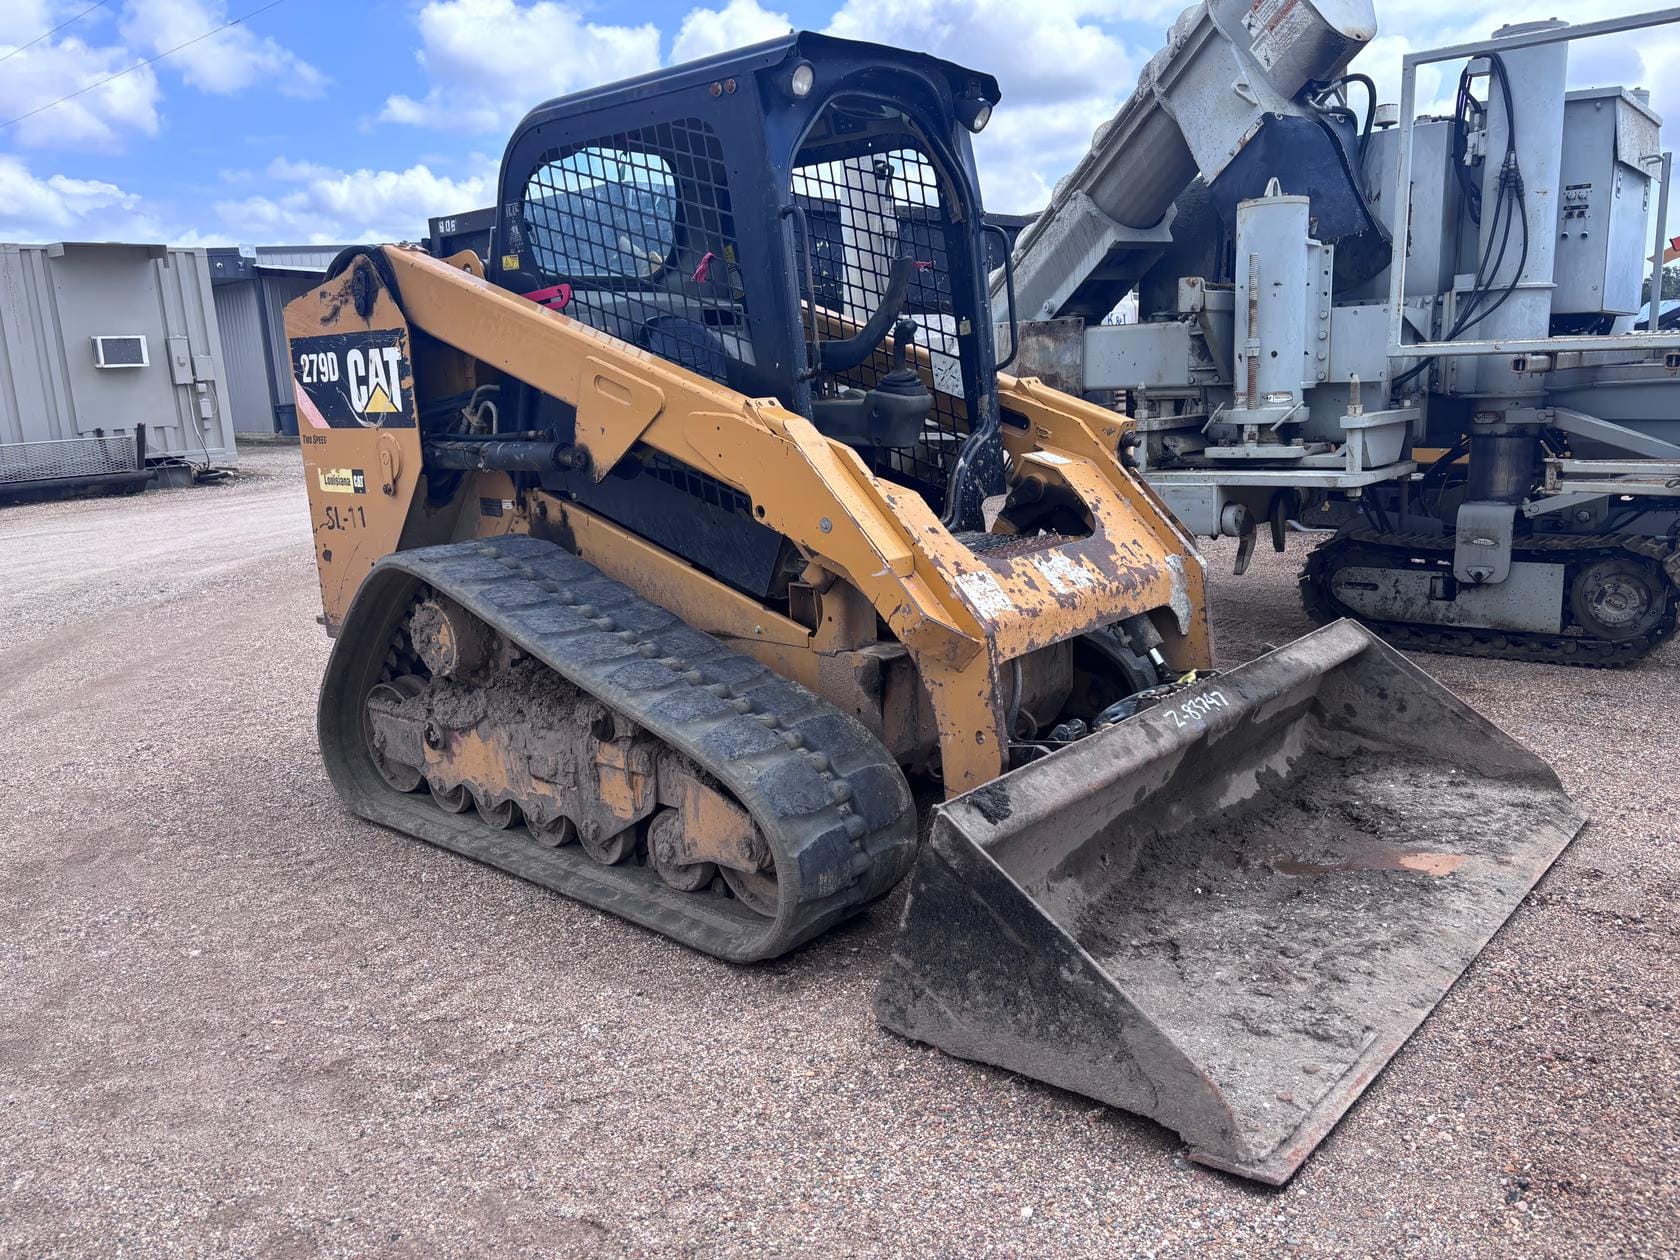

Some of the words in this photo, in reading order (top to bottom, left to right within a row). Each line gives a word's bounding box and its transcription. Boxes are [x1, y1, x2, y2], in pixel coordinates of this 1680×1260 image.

[300, 351, 340, 384] 279D
[347, 346, 403, 413] CAT
[323, 474, 351, 487] Louisiana
[353, 475, 364, 488] CAT
[320, 506, 366, 531] SL-11
